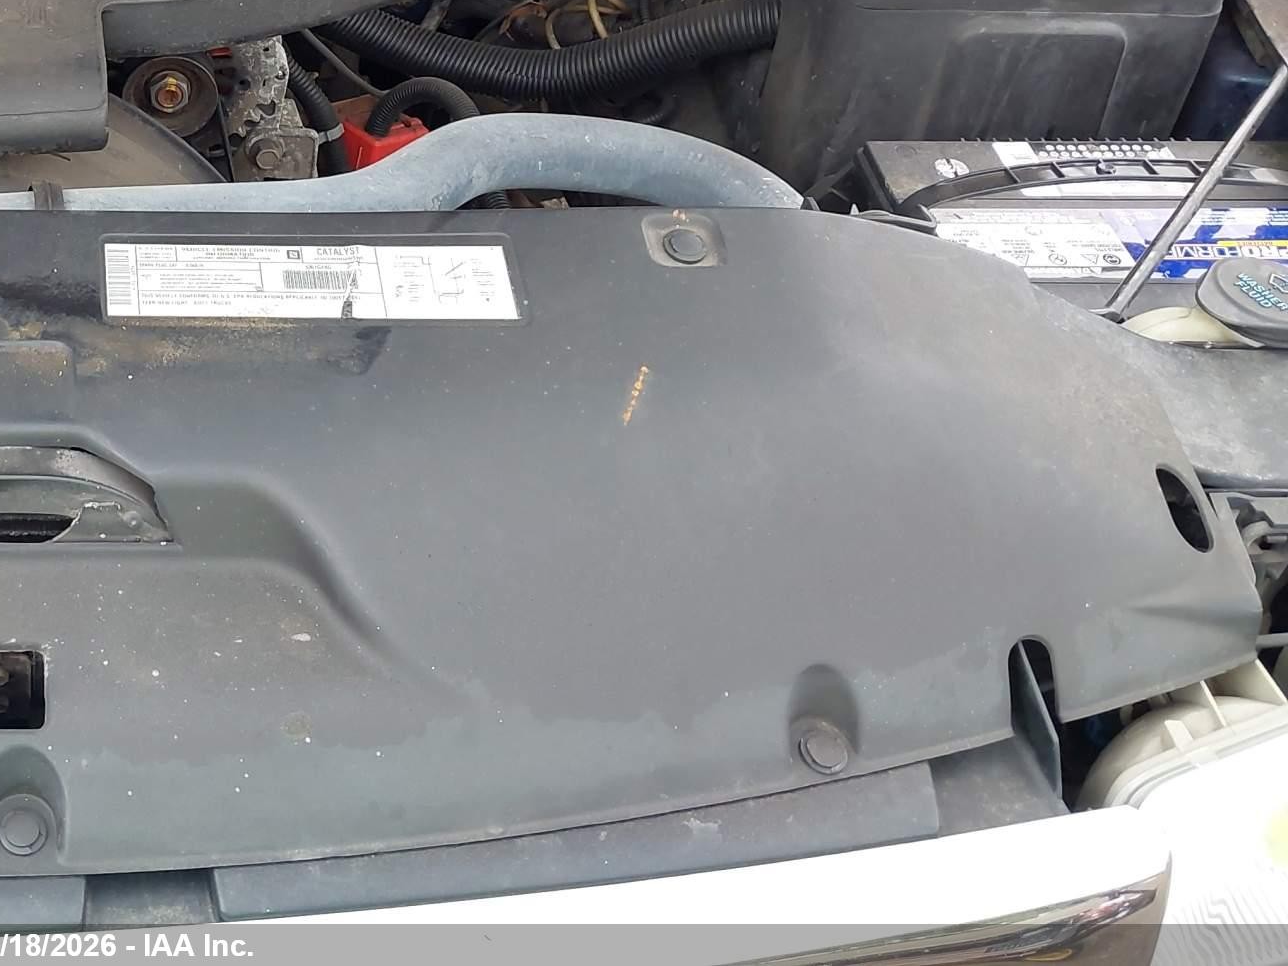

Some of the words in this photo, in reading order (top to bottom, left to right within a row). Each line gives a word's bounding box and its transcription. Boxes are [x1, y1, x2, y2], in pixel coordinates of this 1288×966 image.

[316, 246, 360, 256] CATALYST
[1234, 280, 1273, 308] FLUID
[1237, 273, 1288, 310] WASHER
